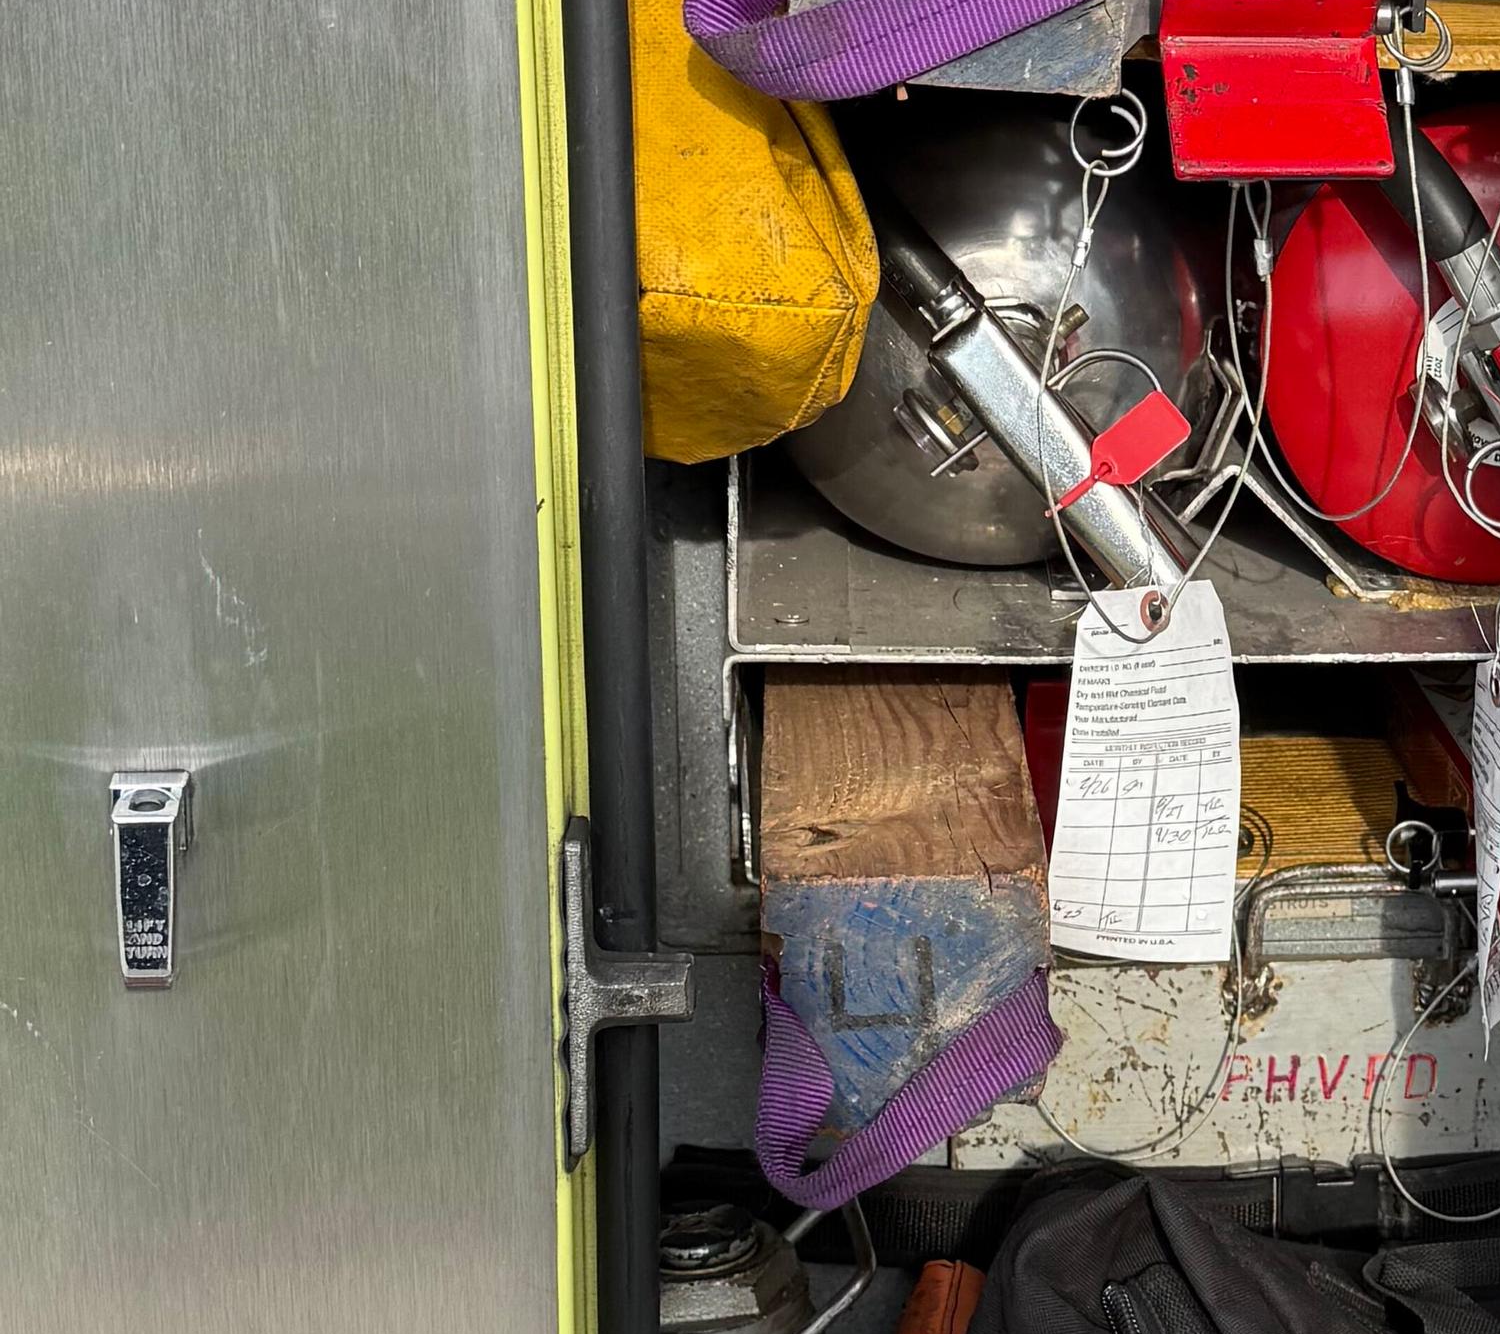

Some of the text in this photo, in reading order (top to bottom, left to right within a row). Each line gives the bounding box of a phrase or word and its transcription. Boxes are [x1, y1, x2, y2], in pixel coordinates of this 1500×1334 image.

[1083, 759, 1105, 767] DATE
[1168, 753, 1189, 763] DATE
[127, 932, 164, 945] AND
[1096, 934, 1136, 945] PRINTED
[126, 945, 168, 959] TURN
